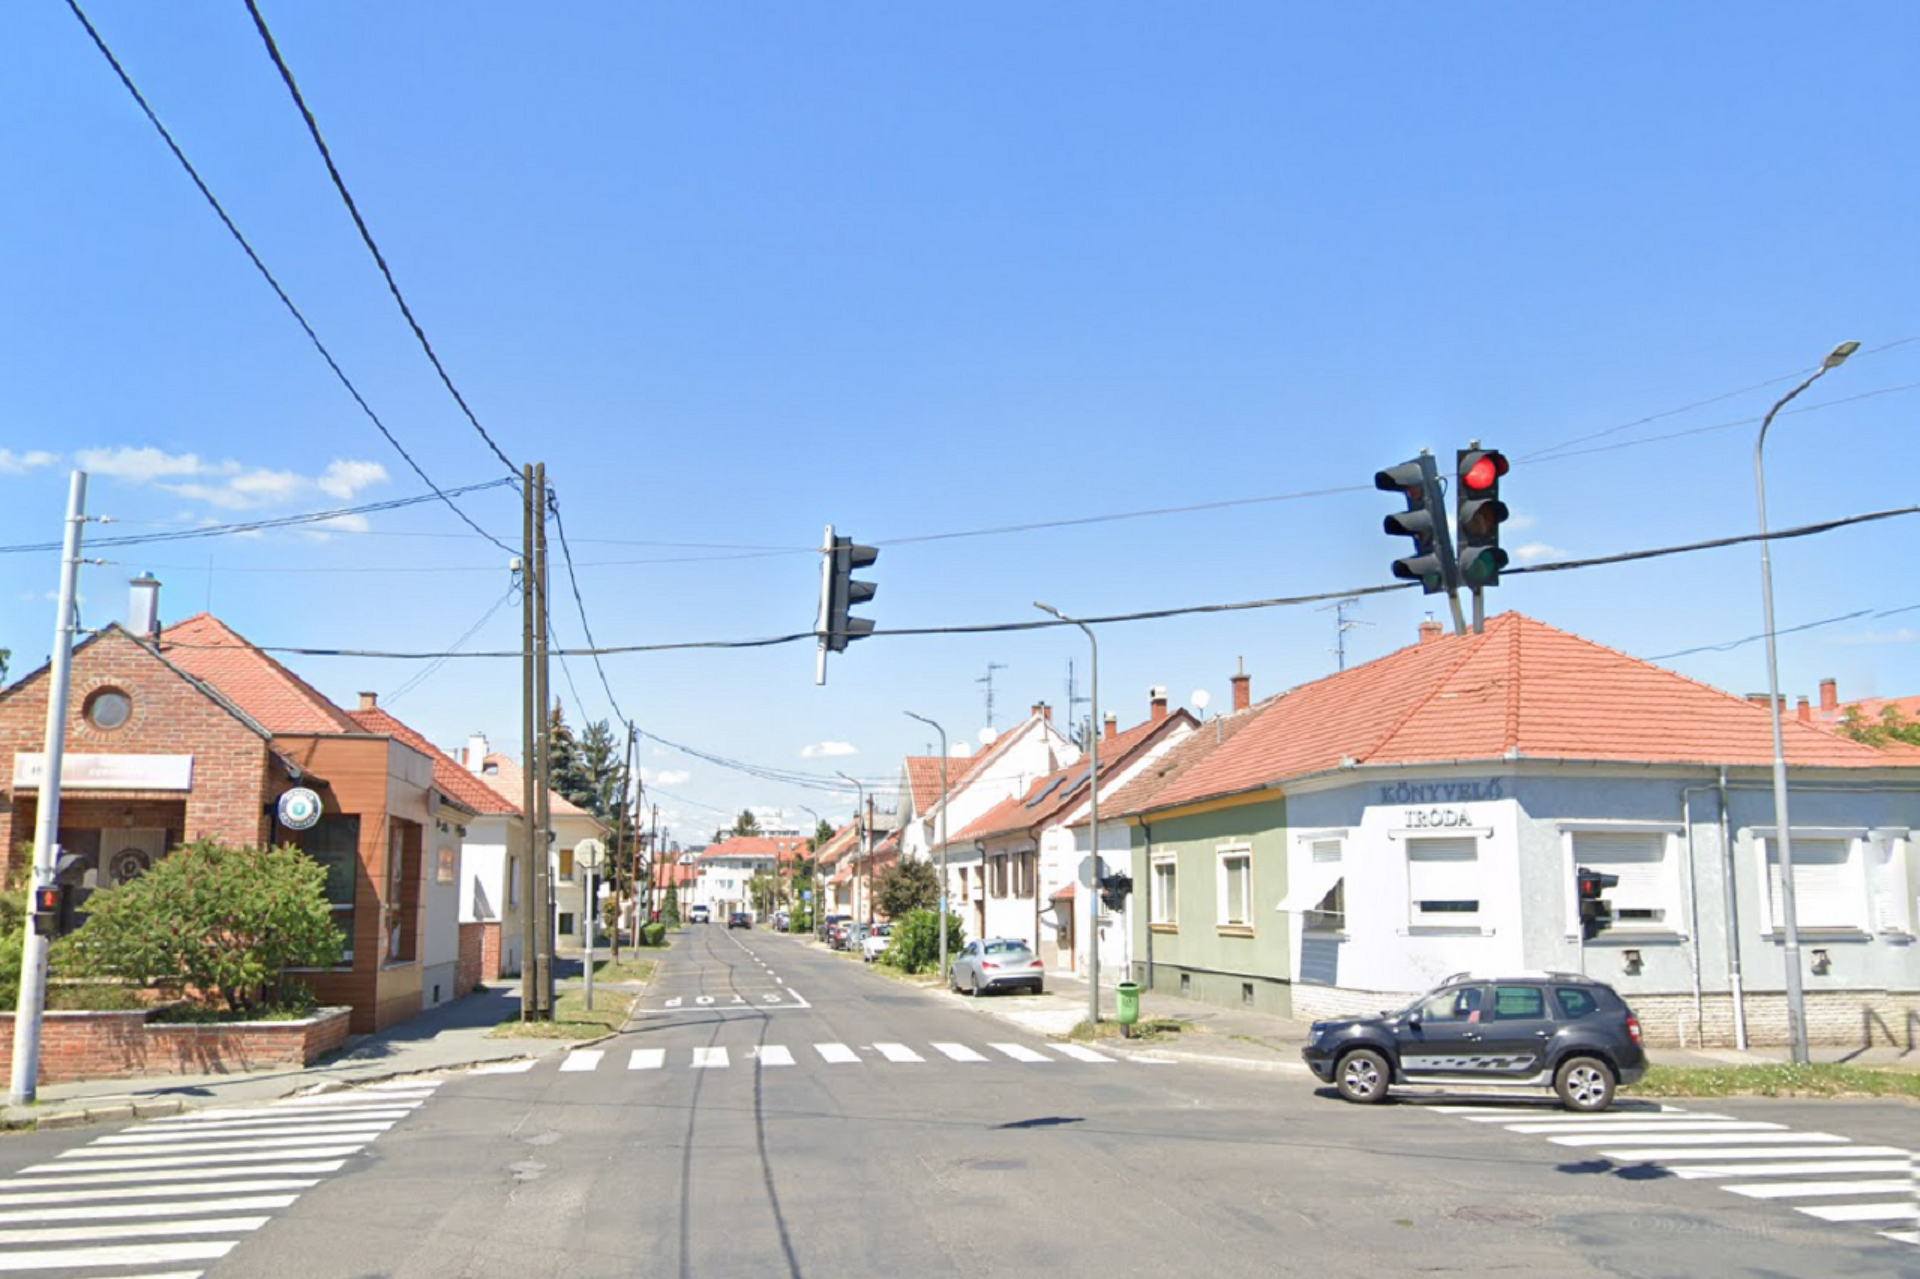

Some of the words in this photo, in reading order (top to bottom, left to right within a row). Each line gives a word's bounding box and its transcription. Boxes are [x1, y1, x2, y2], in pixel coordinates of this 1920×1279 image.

[1381, 777, 1503, 803] KÖNYVELŐ
[1405, 808, 1472, 828] IRODA
[665, 993, 781, 1007] STOP
